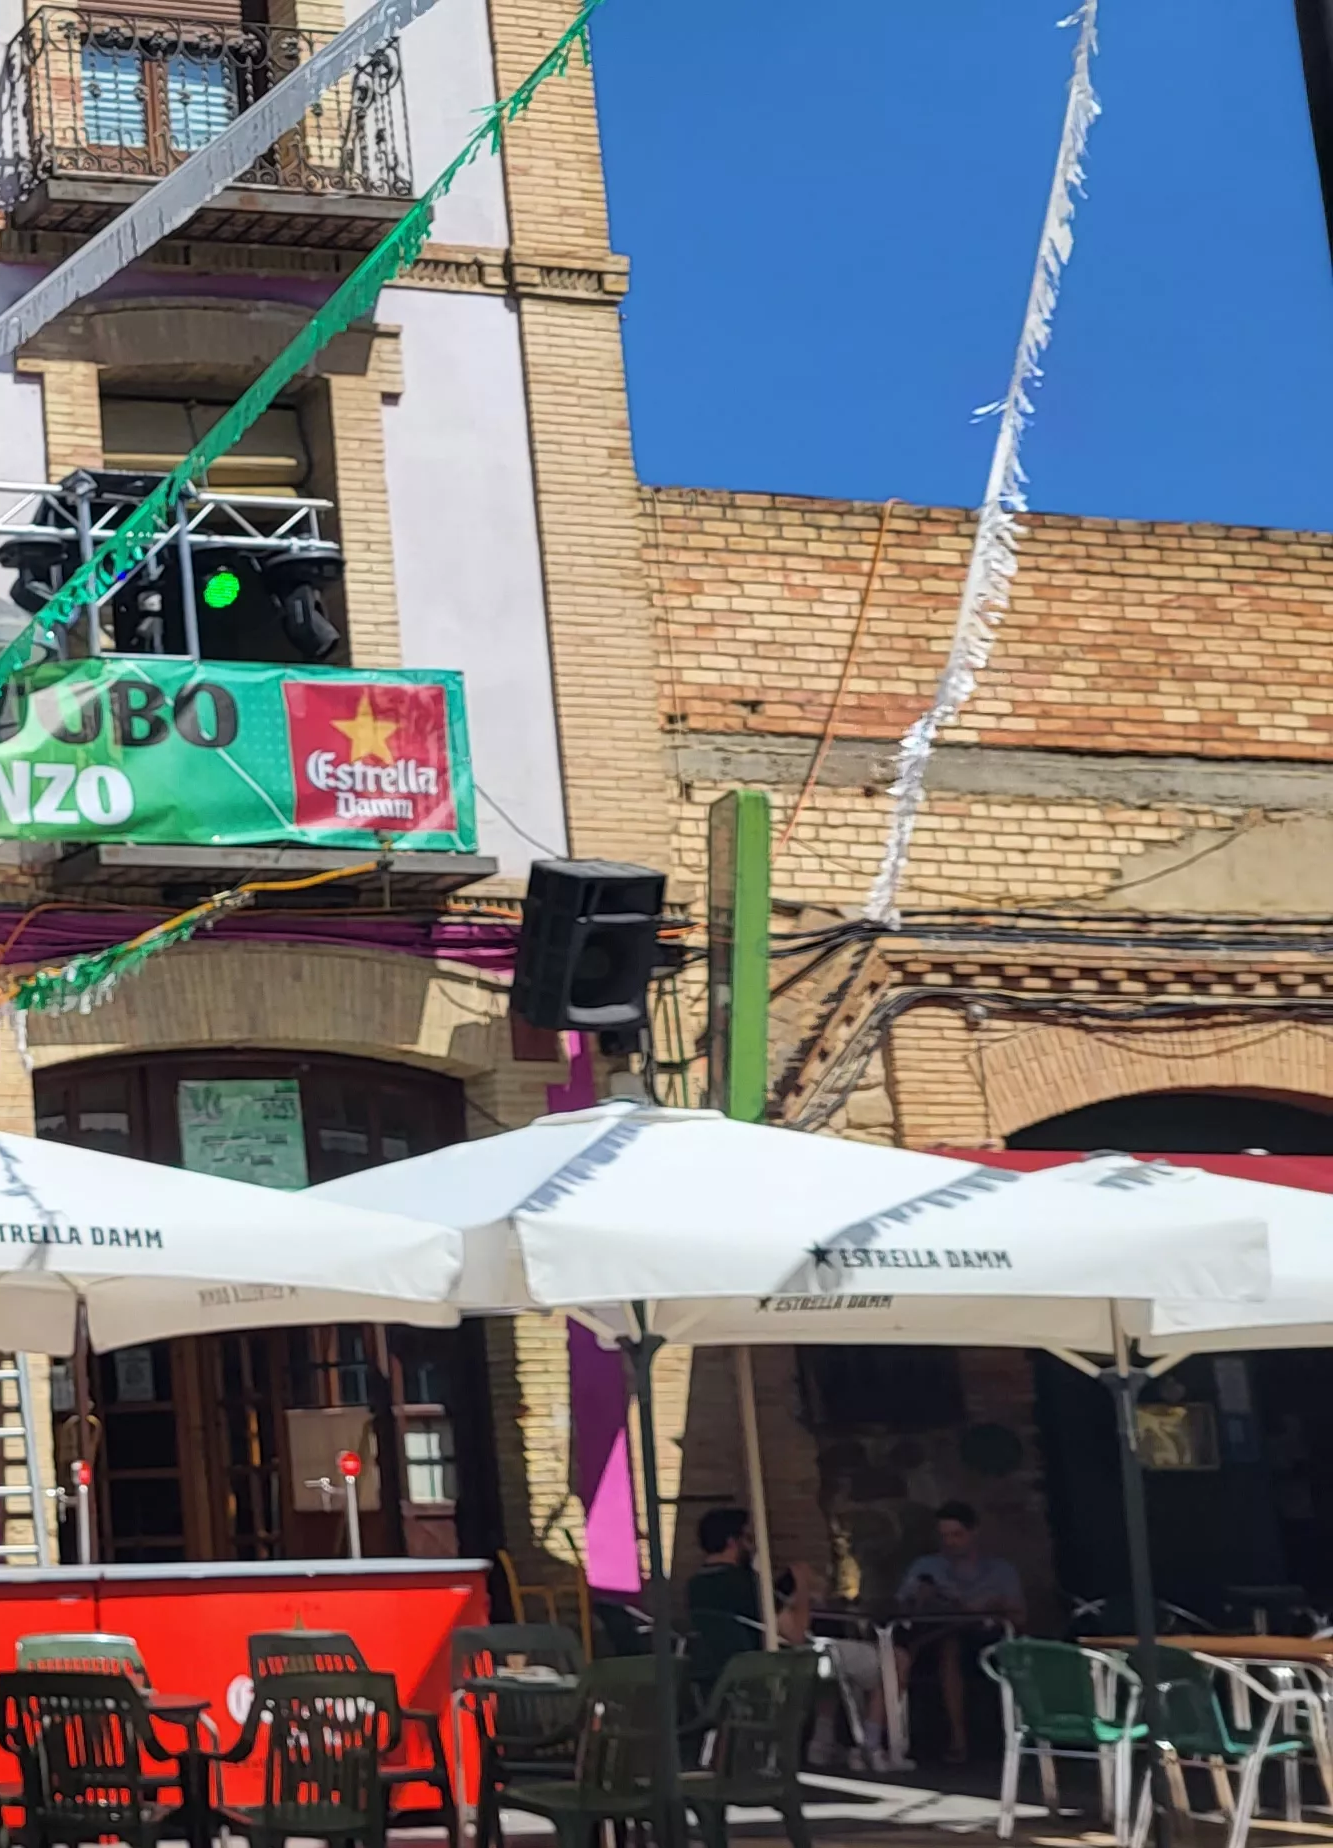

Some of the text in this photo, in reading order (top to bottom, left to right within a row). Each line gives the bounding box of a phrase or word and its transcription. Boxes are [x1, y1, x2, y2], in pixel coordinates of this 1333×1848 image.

[306, 749, 439, 795] Estrella
[334, 791, 414, 820] Damm
[89, 1226, 164, 1249] DAMM
[839, 1247, 1013, 1269] ESTRELLA DAMM
